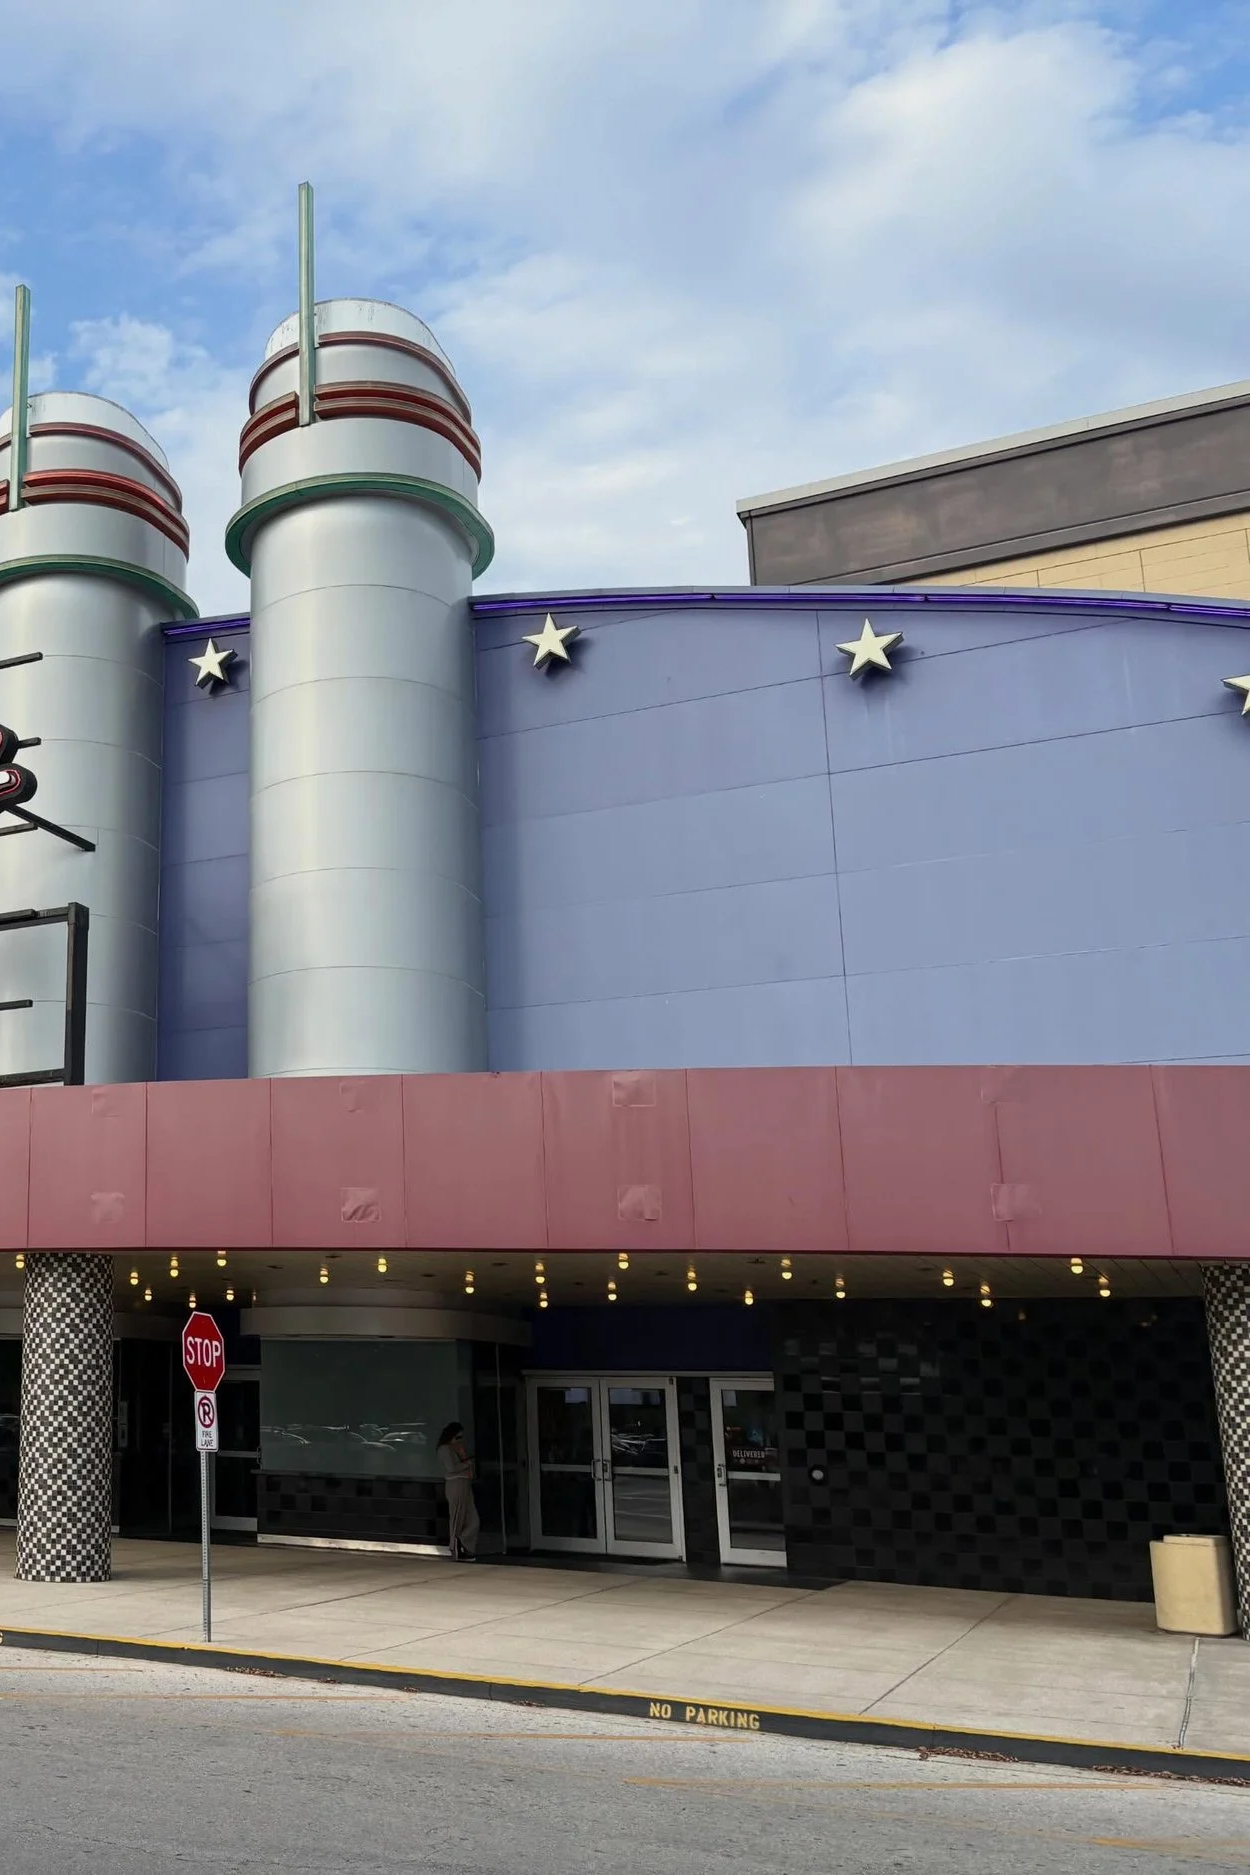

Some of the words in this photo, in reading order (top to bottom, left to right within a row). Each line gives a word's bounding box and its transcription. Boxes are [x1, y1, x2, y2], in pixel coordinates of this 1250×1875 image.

[186, 1336, 221, 1367] STOP
[201, 1430, 213, 1439] FIRE
[200, 1439, 214, 1448] LANE
[732, 1448, 766, 1459] DELIVERED
[649, 1702, 672, 1719] NO
[685, 1705, 761, 1730] PARKING
